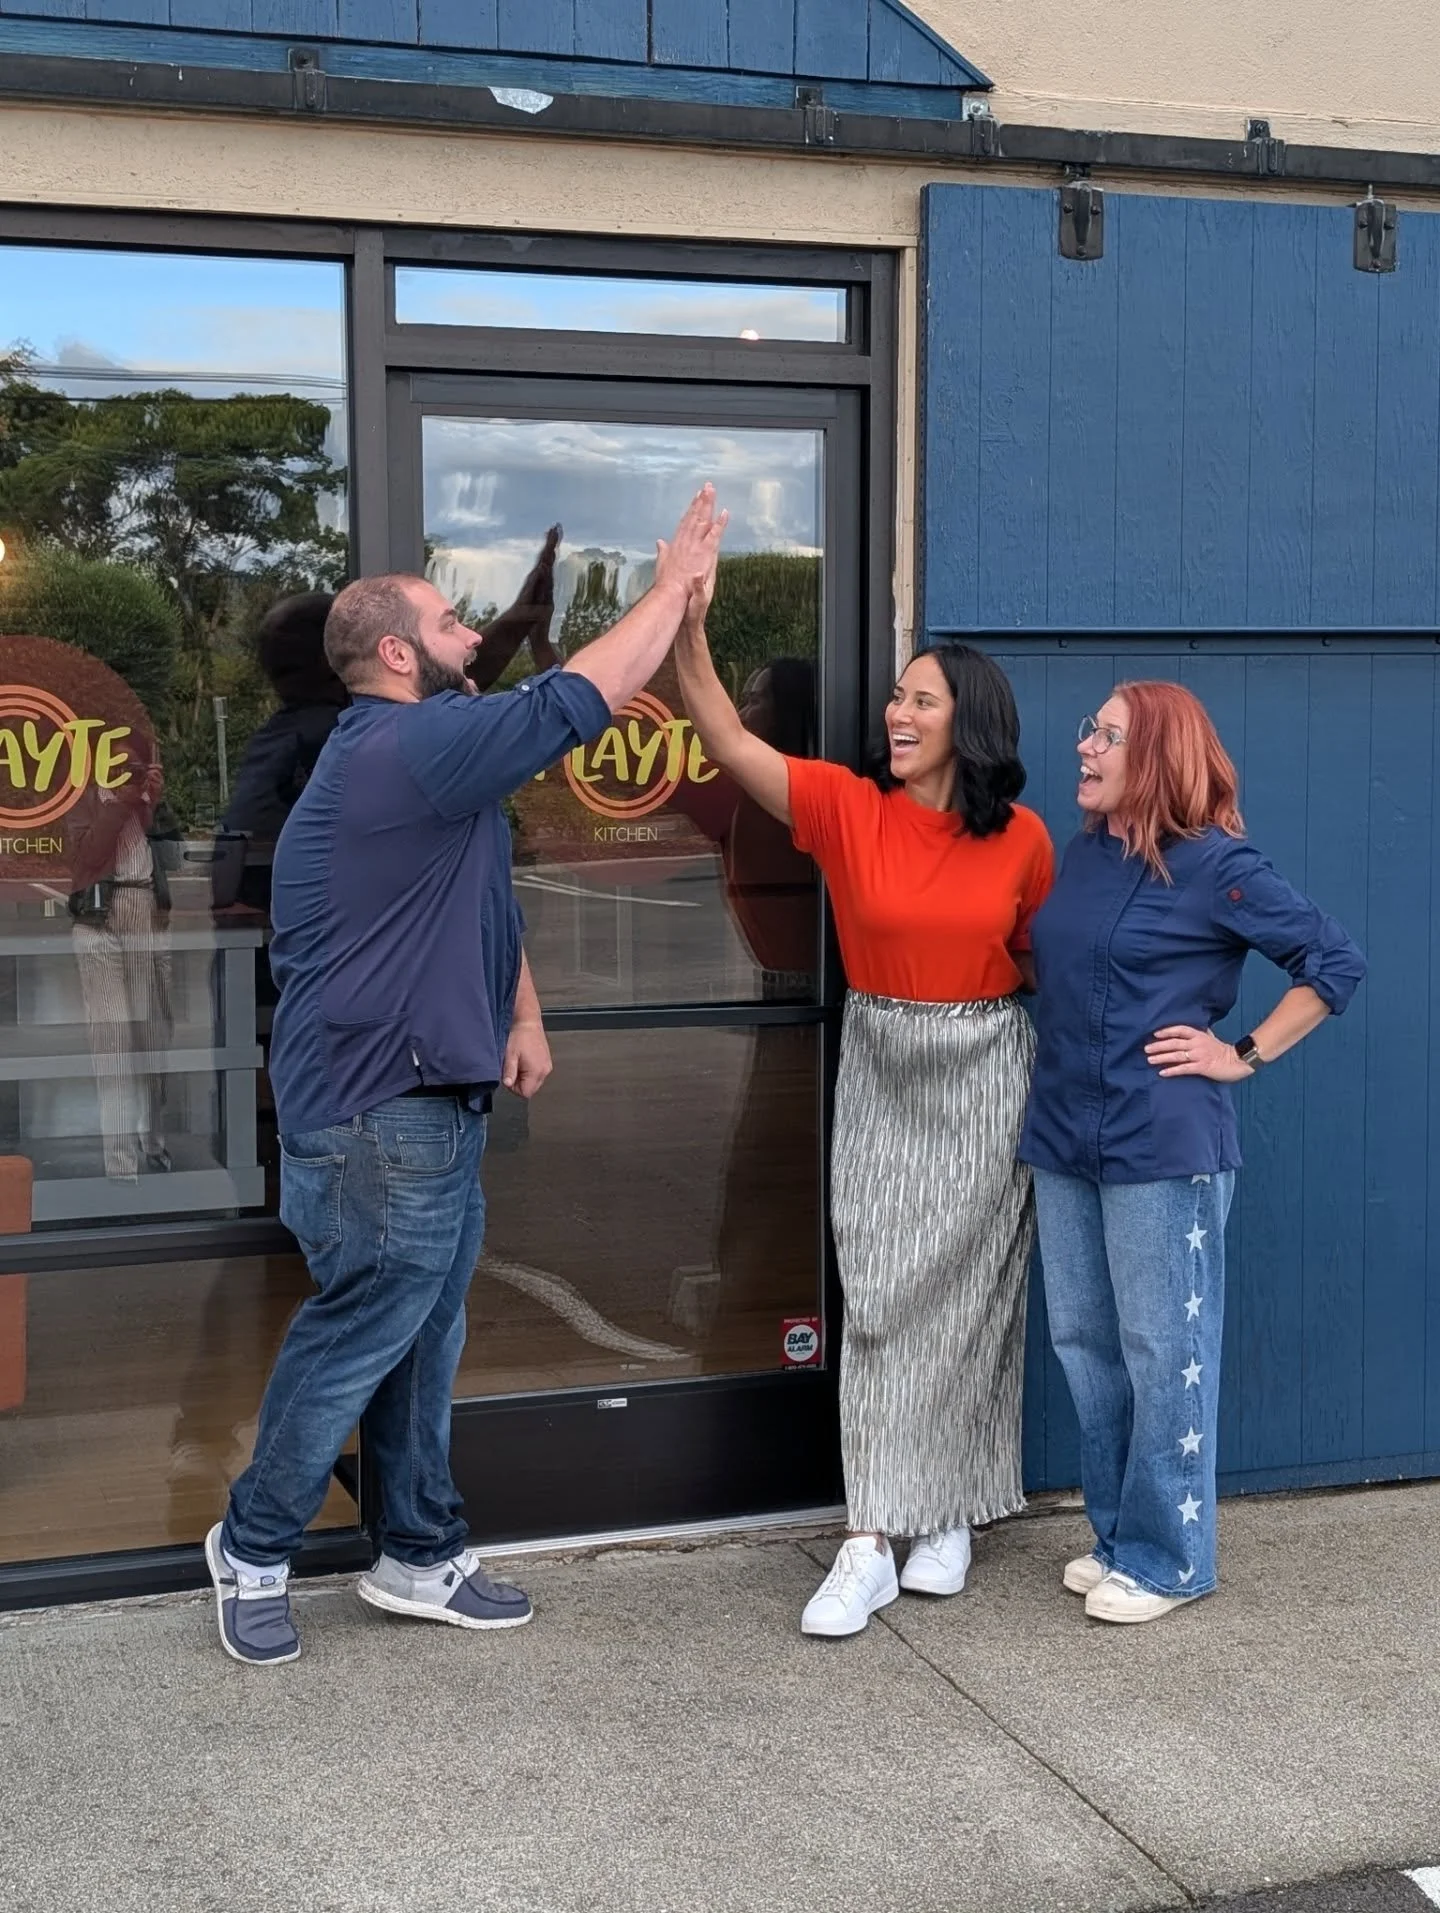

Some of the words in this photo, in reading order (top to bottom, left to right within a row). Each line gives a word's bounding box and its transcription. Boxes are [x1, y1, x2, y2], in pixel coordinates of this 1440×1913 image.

[534, 719, 720, 785] LAYTE
[594, 827, 658, 842] KITCHEN
[787, 1332, 814, 1345] BAY
[787, 1344, 813, 1352] ALARM
